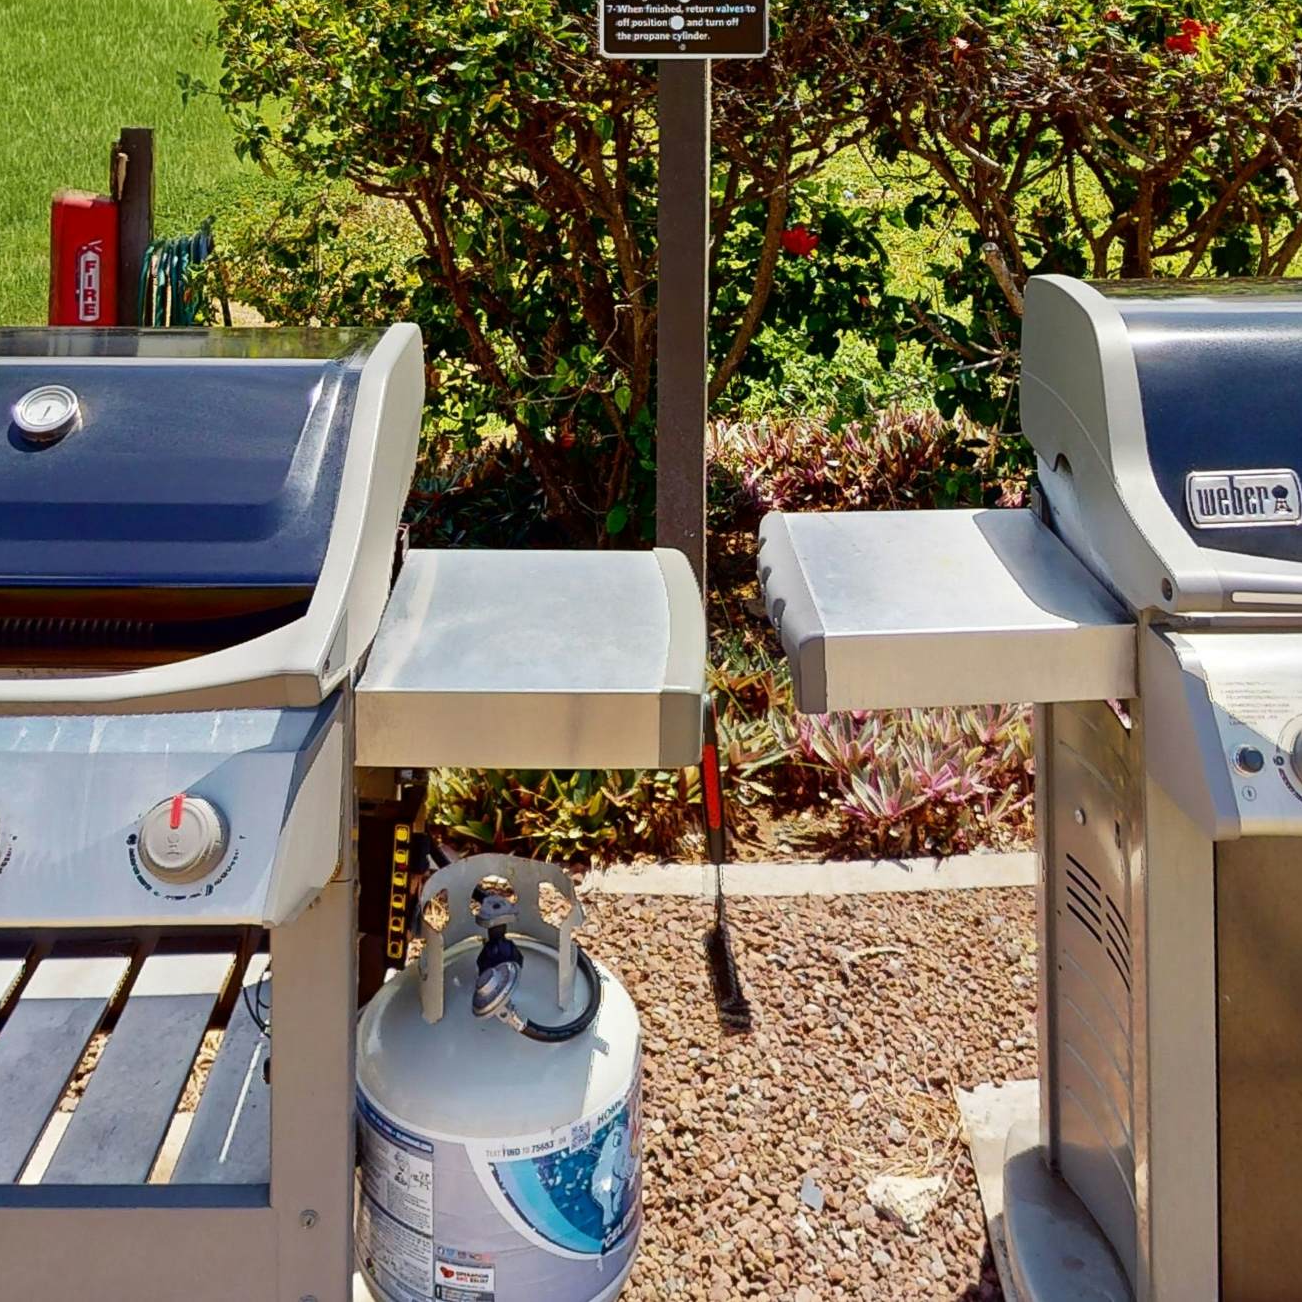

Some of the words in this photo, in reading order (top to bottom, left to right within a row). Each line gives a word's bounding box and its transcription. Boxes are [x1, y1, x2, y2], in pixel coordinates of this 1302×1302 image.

[685, 5, 714, 14] return
[715, 4, 745, 13] valves
[746, 5, 756, 13] to
[616, 17, 630, 27] off
[630, 18, 668, 29] position
[686, 17, 704, 27] and
[705, 18, 725, 27] turn
[725, 17, 739, 27] off
[615, 31, 632, 40] the
[633, 33, 671, 42] propane
[83, 260, 98, 316] FIRE
[1196, 474, 1269, 517] weber
